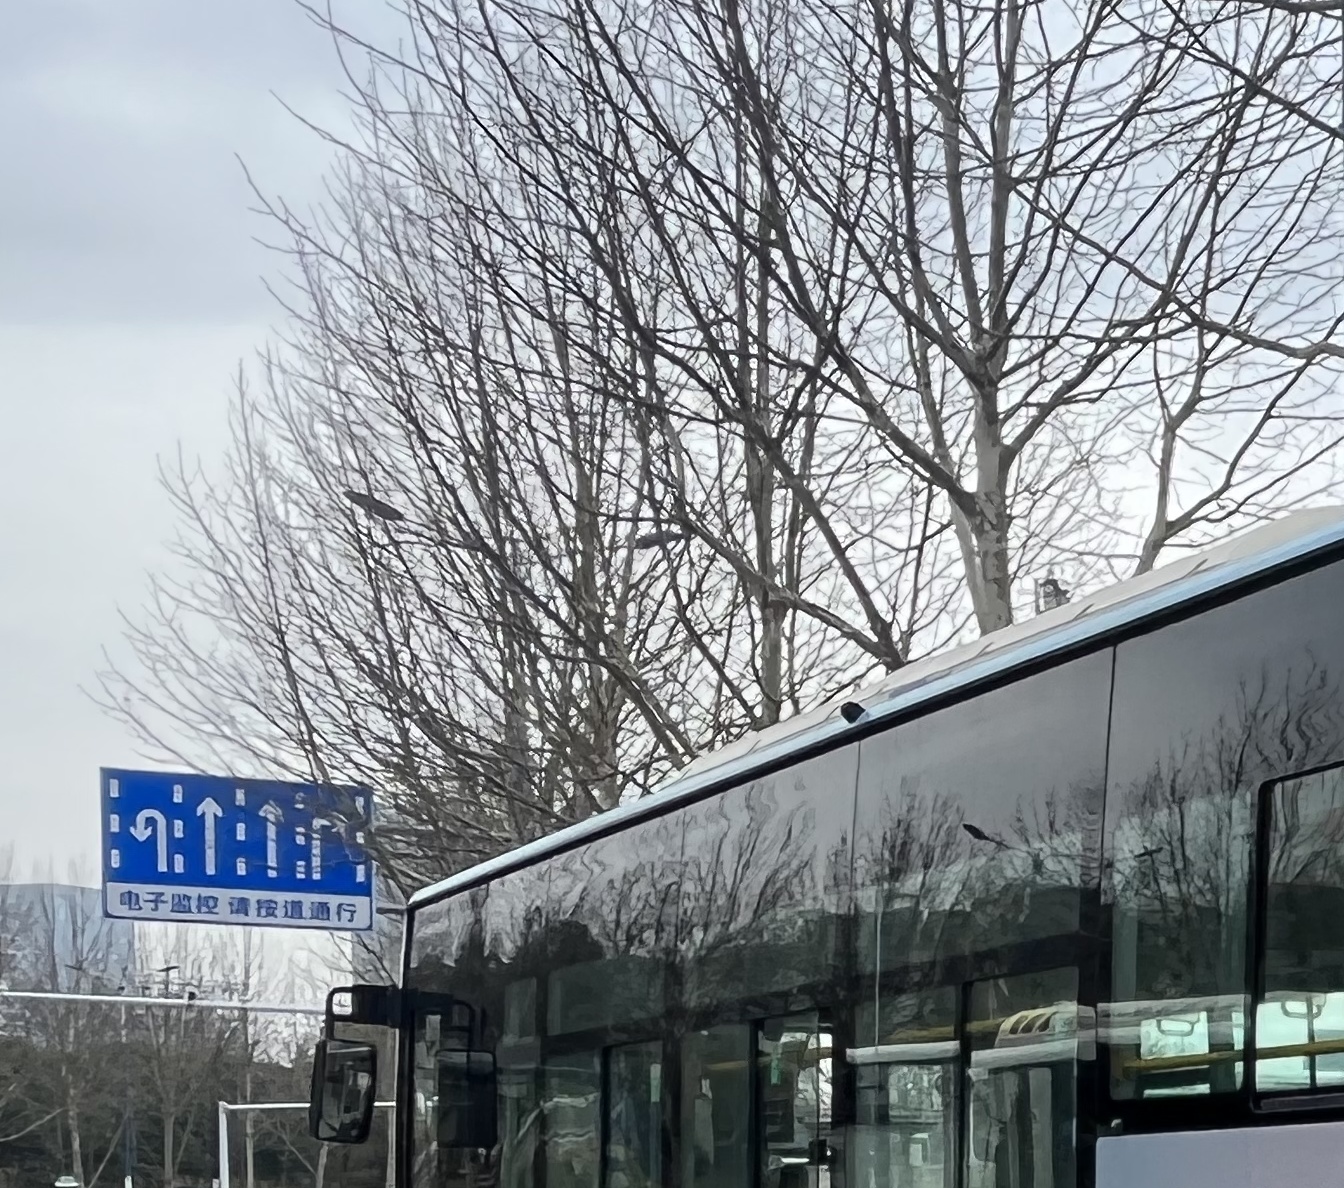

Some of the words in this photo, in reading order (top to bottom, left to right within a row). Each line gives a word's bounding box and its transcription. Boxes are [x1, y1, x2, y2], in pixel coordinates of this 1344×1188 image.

[119, 890, 220, 915] 电子监控
[228, 896, 358, 923] 请按道通行
